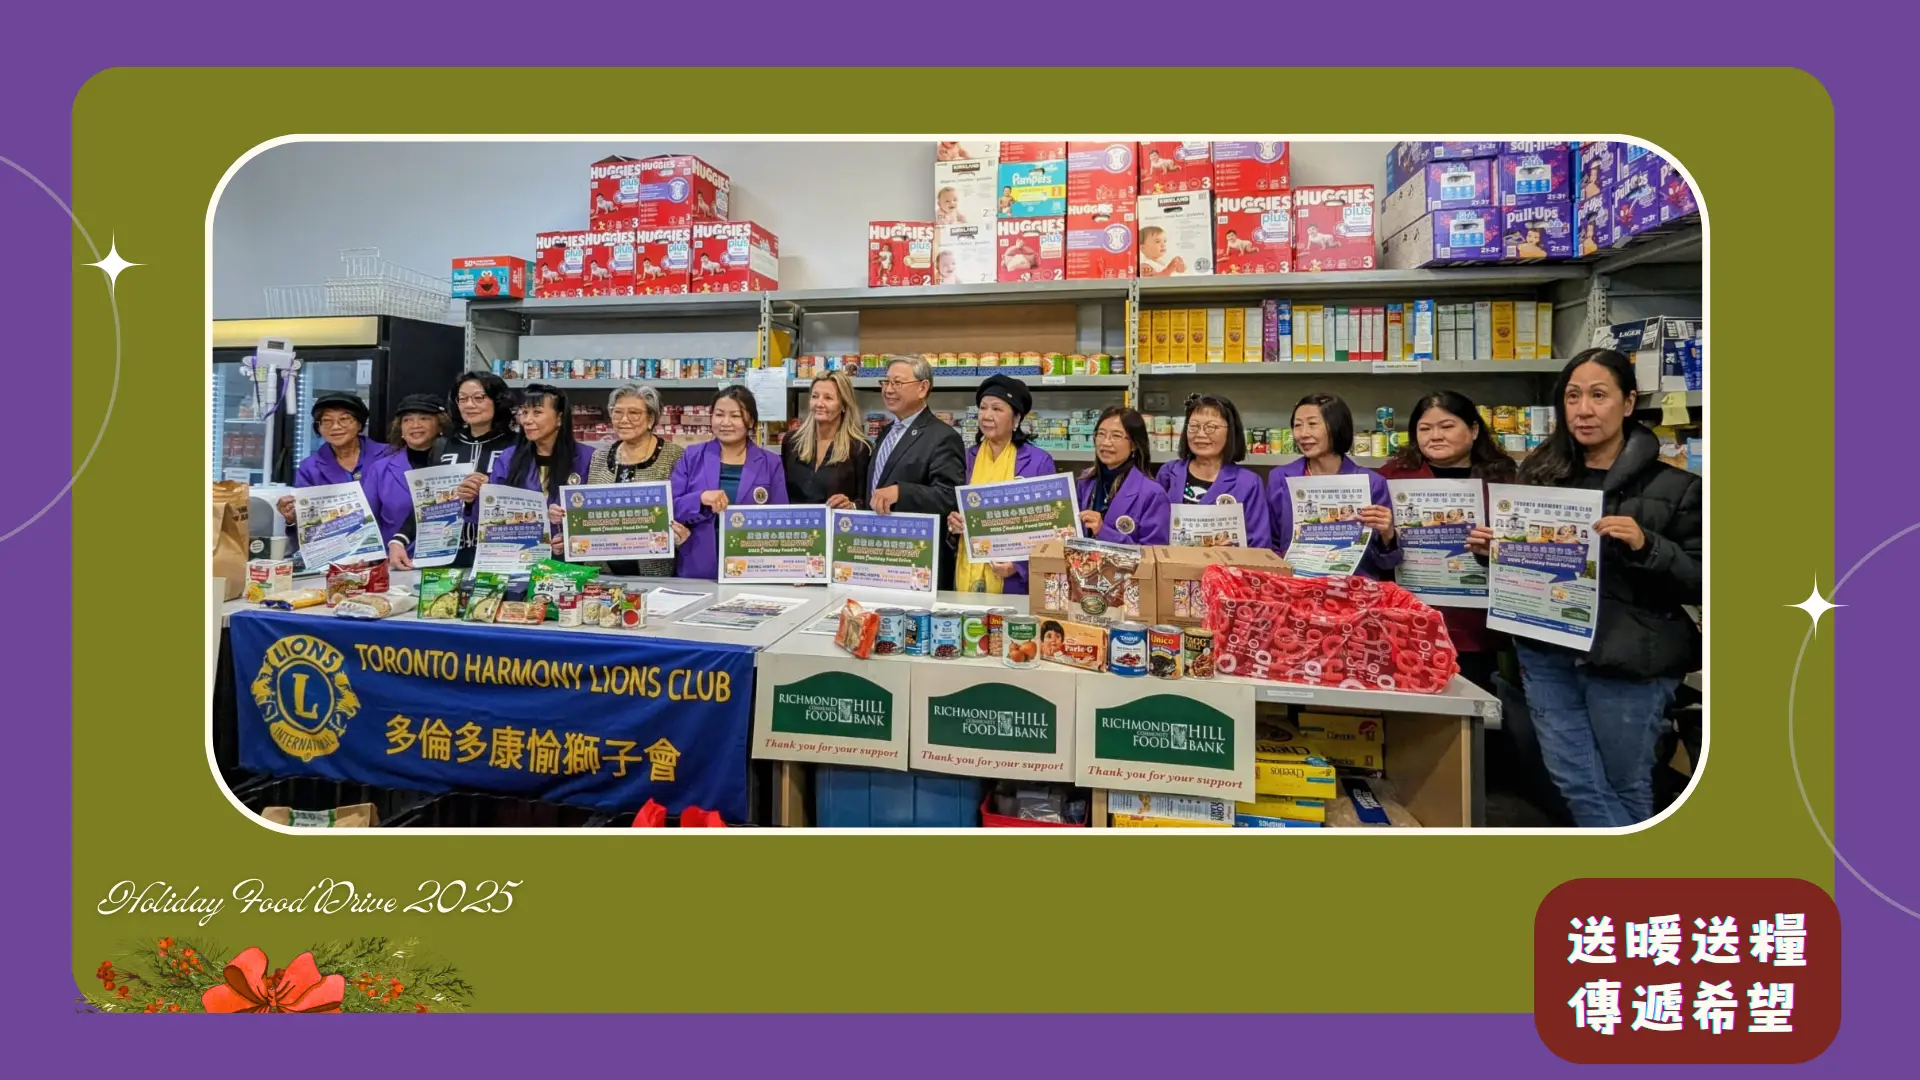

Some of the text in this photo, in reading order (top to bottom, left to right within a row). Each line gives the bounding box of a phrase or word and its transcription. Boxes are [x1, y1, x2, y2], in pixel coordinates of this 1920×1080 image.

[590, 164, 641, 180] HUGGIES
[641, 160, 675, 171] HUGGIES
[620, 177, 640, 188] plus
[692, 158, 730, 193] HUGGIES
[1012, 173, 1052, 185] Pampers
[1202, 177, 1211, 188] 3
[1280, 176, 1287, 184] 3
[1217, 196, 1291, 213] HUGGIES
[1296, 189, 1374, 206] HUGGIES
[1262, 211, 1289, 225] plus
[1344, 203, 1371, 218] plus
[1506, 207, 1559, 229] Pull-Ups
[631, 218, 639, 228] 3
[997, 219, 1065, 236] HUGGIES
[585, 231, 636, 246] HUGGIES
[636, 229, 690, 244] HUGGIES
[693, 224, 751, 238] HUGGIES
[869, 226, 934, 241] HUGGIES
[536, 236, 585, 249] HUGGIES
[728, 237, 749, 249] plus
[910, 240, 931, 251] plus
[1040, 233, 1062, 246] plus
[668, 242, 689, 254] plus
[1280, 261, 1290, 274] 3
[1363, 256, 1373, 268] 3
[923, 275, 931, 286] 2
[1053, 269, 1063, 280] 2
[680, 285, 688, 295] 3
[741, 281, 749, 292] 3
[1619, 328, 1642, 338] LAGER
[537, 582, 574, 592] 出前一丁
[990, 617, 1003, 625] Uni
[1151, 634, 1174, 645] Unico
[1226, 633, 1239, 653] HO
[275, 637, 339, 671] LIONS
[1065, 645, 1093, 653] Parle-G
[1245, 639, 1259, 659] HO
[1418, 640, 1431, 661] HO
[1251, 649, 1272, 678] HO
[354, 643, 732, 703] TORONTO HARMONY LIONS CLUB
[1366, 662, 1380, 683] HO
[292, 673, 318, 720] L
[779, 693, 886, 714] RICHMOND HILL
[805, 710, 884, 726] FOOD BANK
[934, 705, 1049, 726] RICHMOND HILL
[963, 723, 1048, 739] FOOD BANK
[1102, 717, 1226, 741] RICHMOND HILL
[385, 714, 682, 783] 多倫多康愉獅子會
[765, 738, 899, 758] Thank you for your support
[1133, 736, 1225, 754] FOOD BANK
[921, 750, 1064, 772] Thank you for your support
[1087, 765, 1243, 789] Thank you for your support
[1270, 767, 1304, 778] Cheerios
